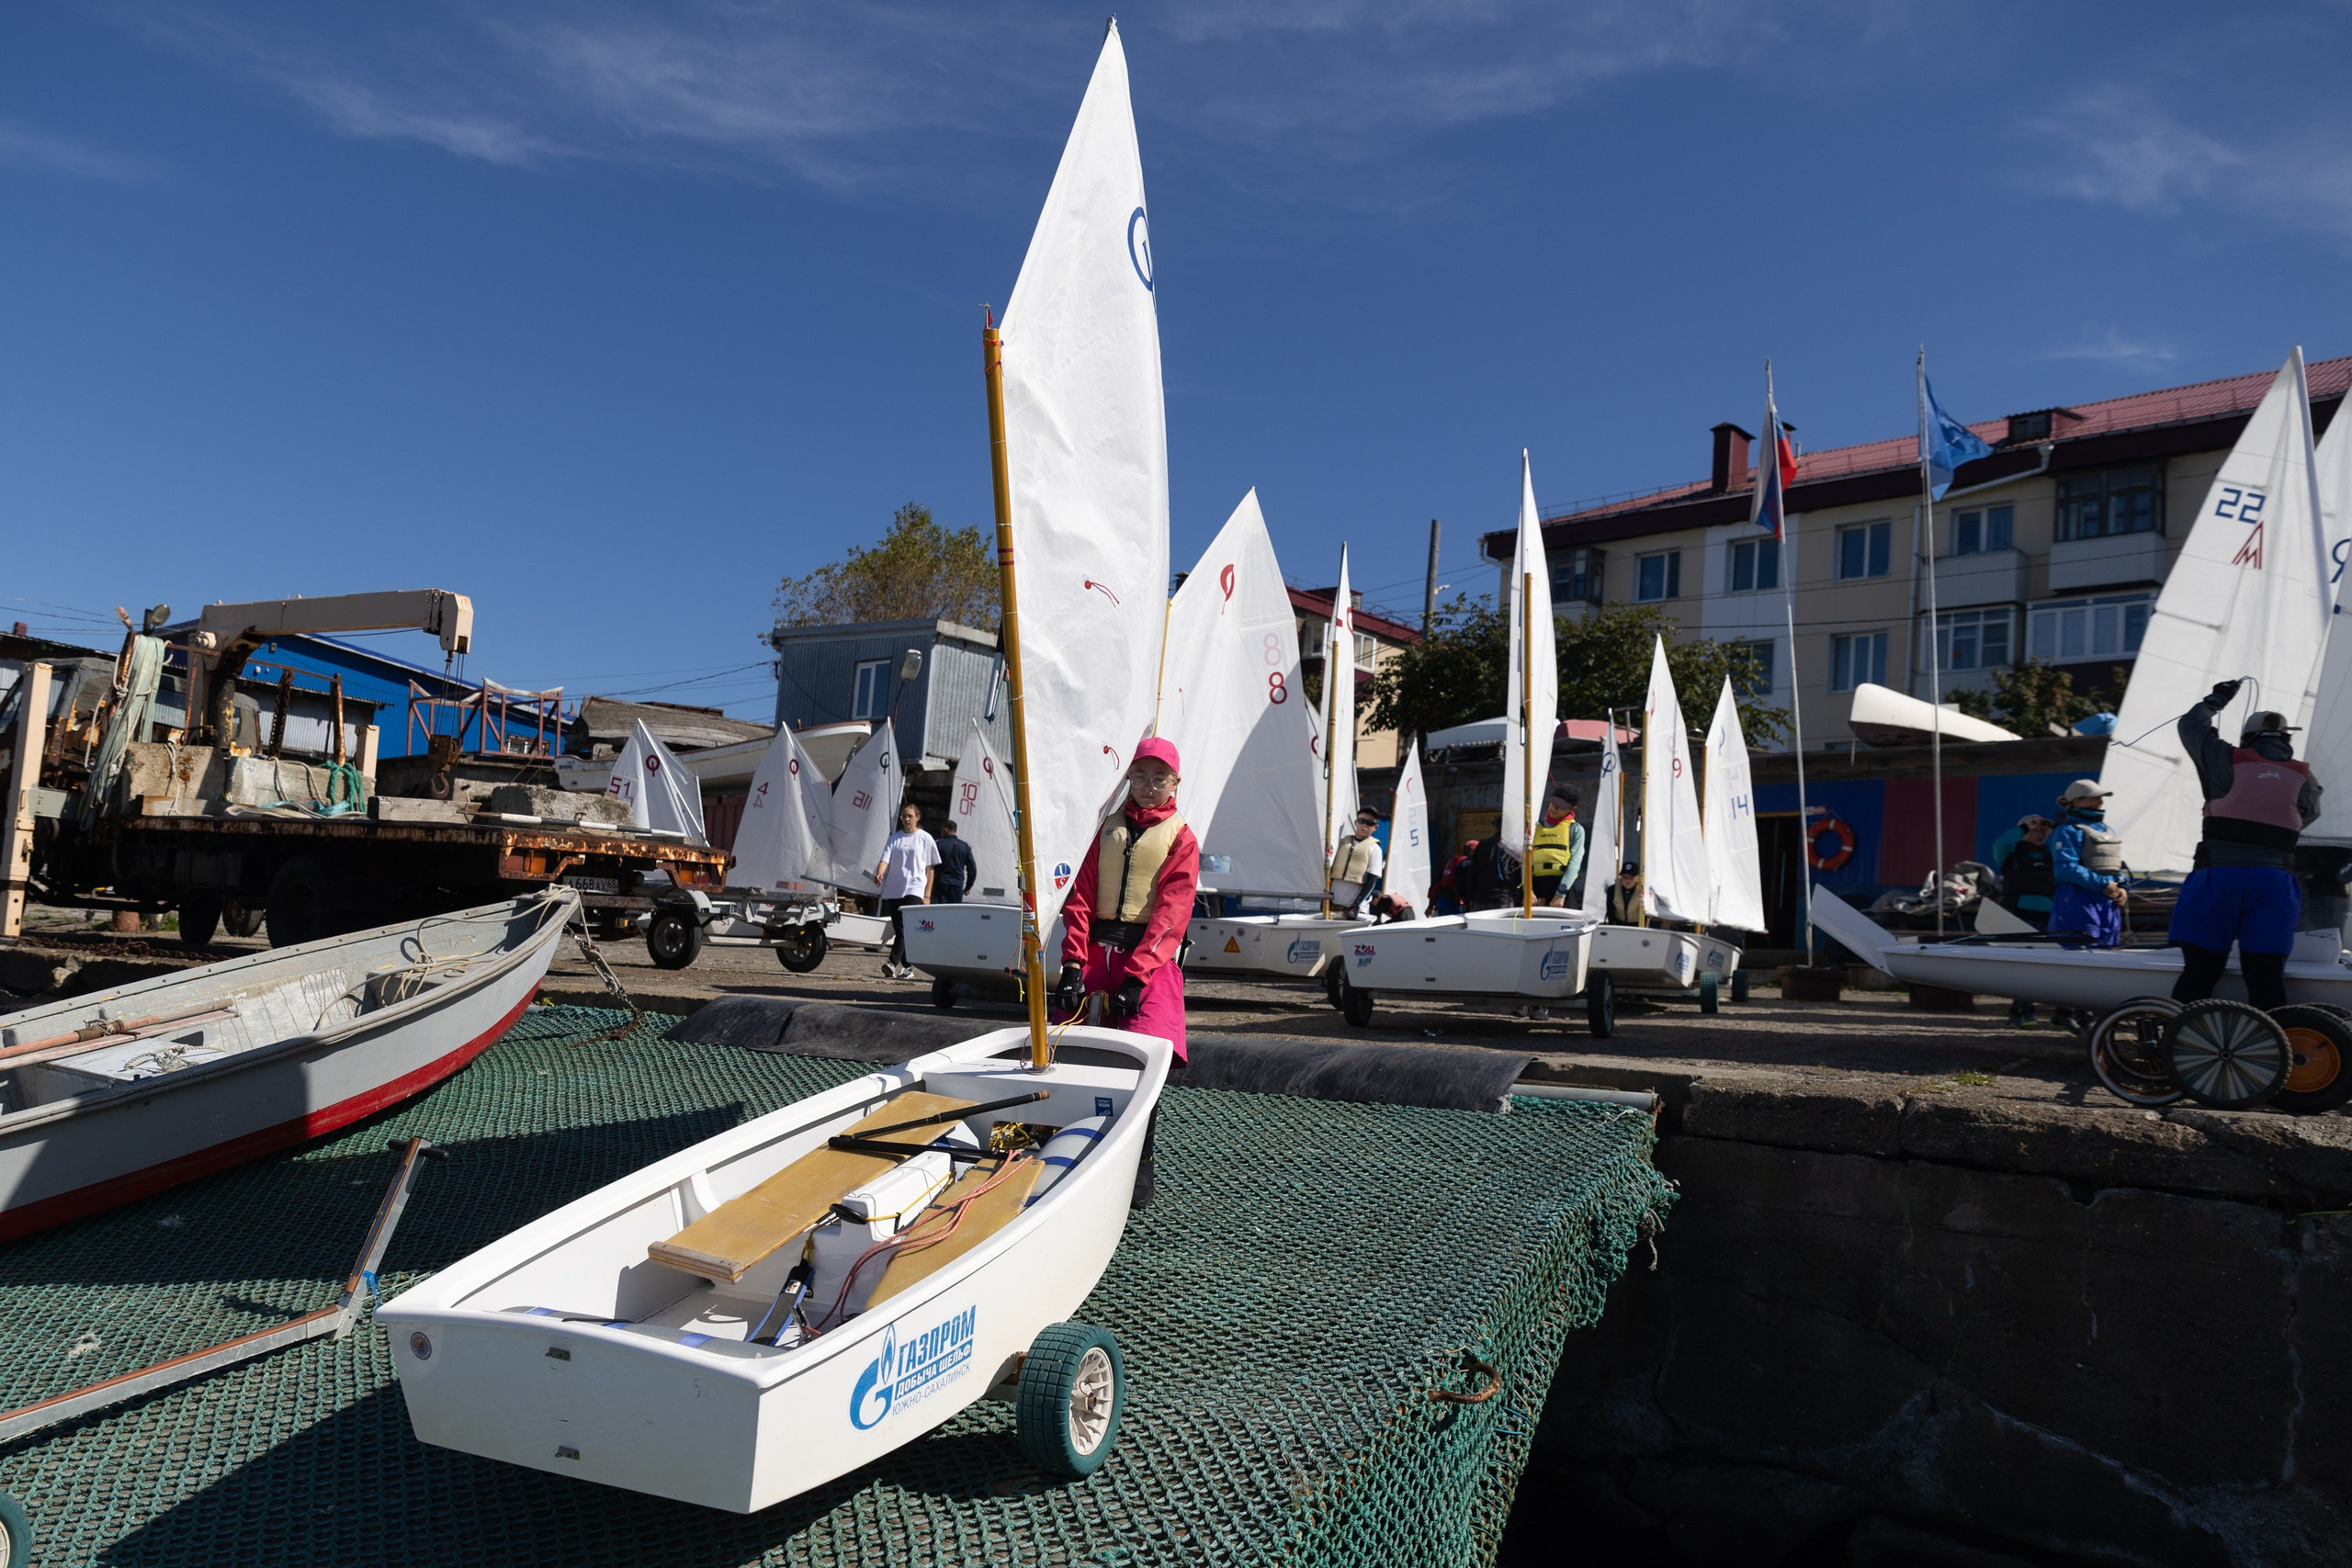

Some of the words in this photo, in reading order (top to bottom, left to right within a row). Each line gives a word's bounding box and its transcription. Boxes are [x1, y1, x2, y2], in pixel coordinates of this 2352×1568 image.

[2214, 488, 2267, 525] 22
[1269, 671, 1288, 705] 8
[1672, 758, 1682, 779] 9
[609, 776, 631, 796] 51
[757, 782, 769, 795] 4
[961, 782, 978, 801] 10
[1731, 794, 1749, 819] 14
[1410, 829, 1419, 847] 5
[898, 1304, 976, 1378] ГАЗПРОМ
[897, 1365, 937, 1399] ДОБЫЧА
[939, 1344, 971, 1372] ШЕЛЬФ
[892, 1361, 971, 1416] ЮЖНО-САХАЛИНСК
